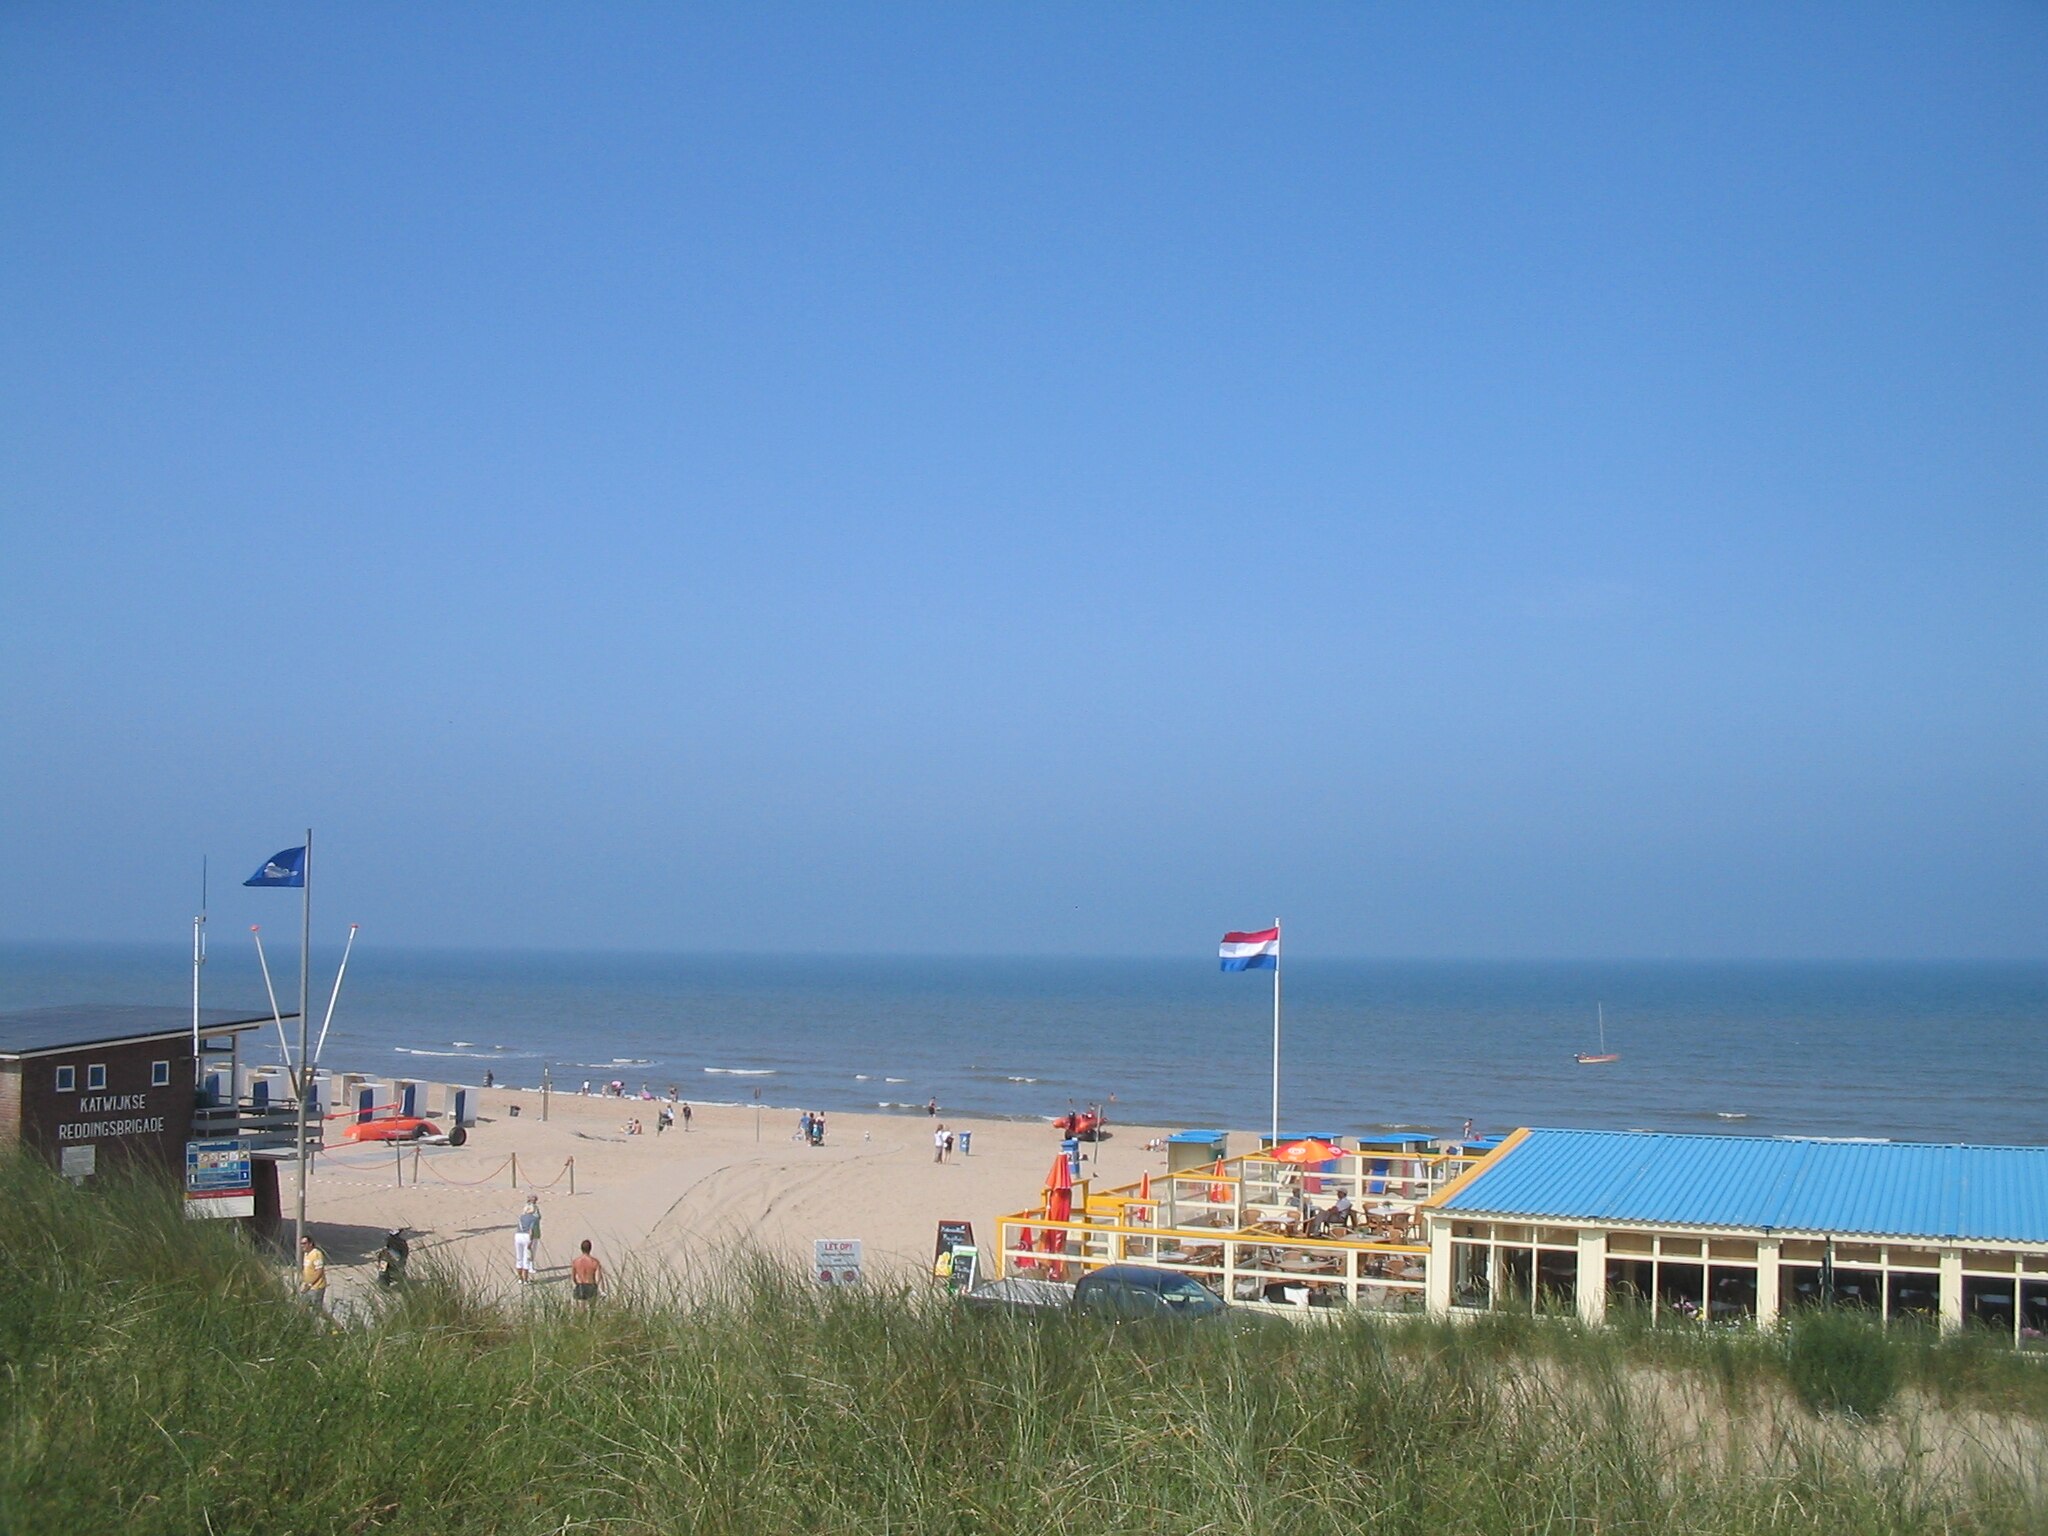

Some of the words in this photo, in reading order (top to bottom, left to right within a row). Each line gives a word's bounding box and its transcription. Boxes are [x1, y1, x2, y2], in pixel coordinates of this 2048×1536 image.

[80, 1094, 146, 1113] KATWIJKSE
[59, 1117, 164, 1140] REDDINGSBRIGADE
[824, 1243, 838, 1251] LET
